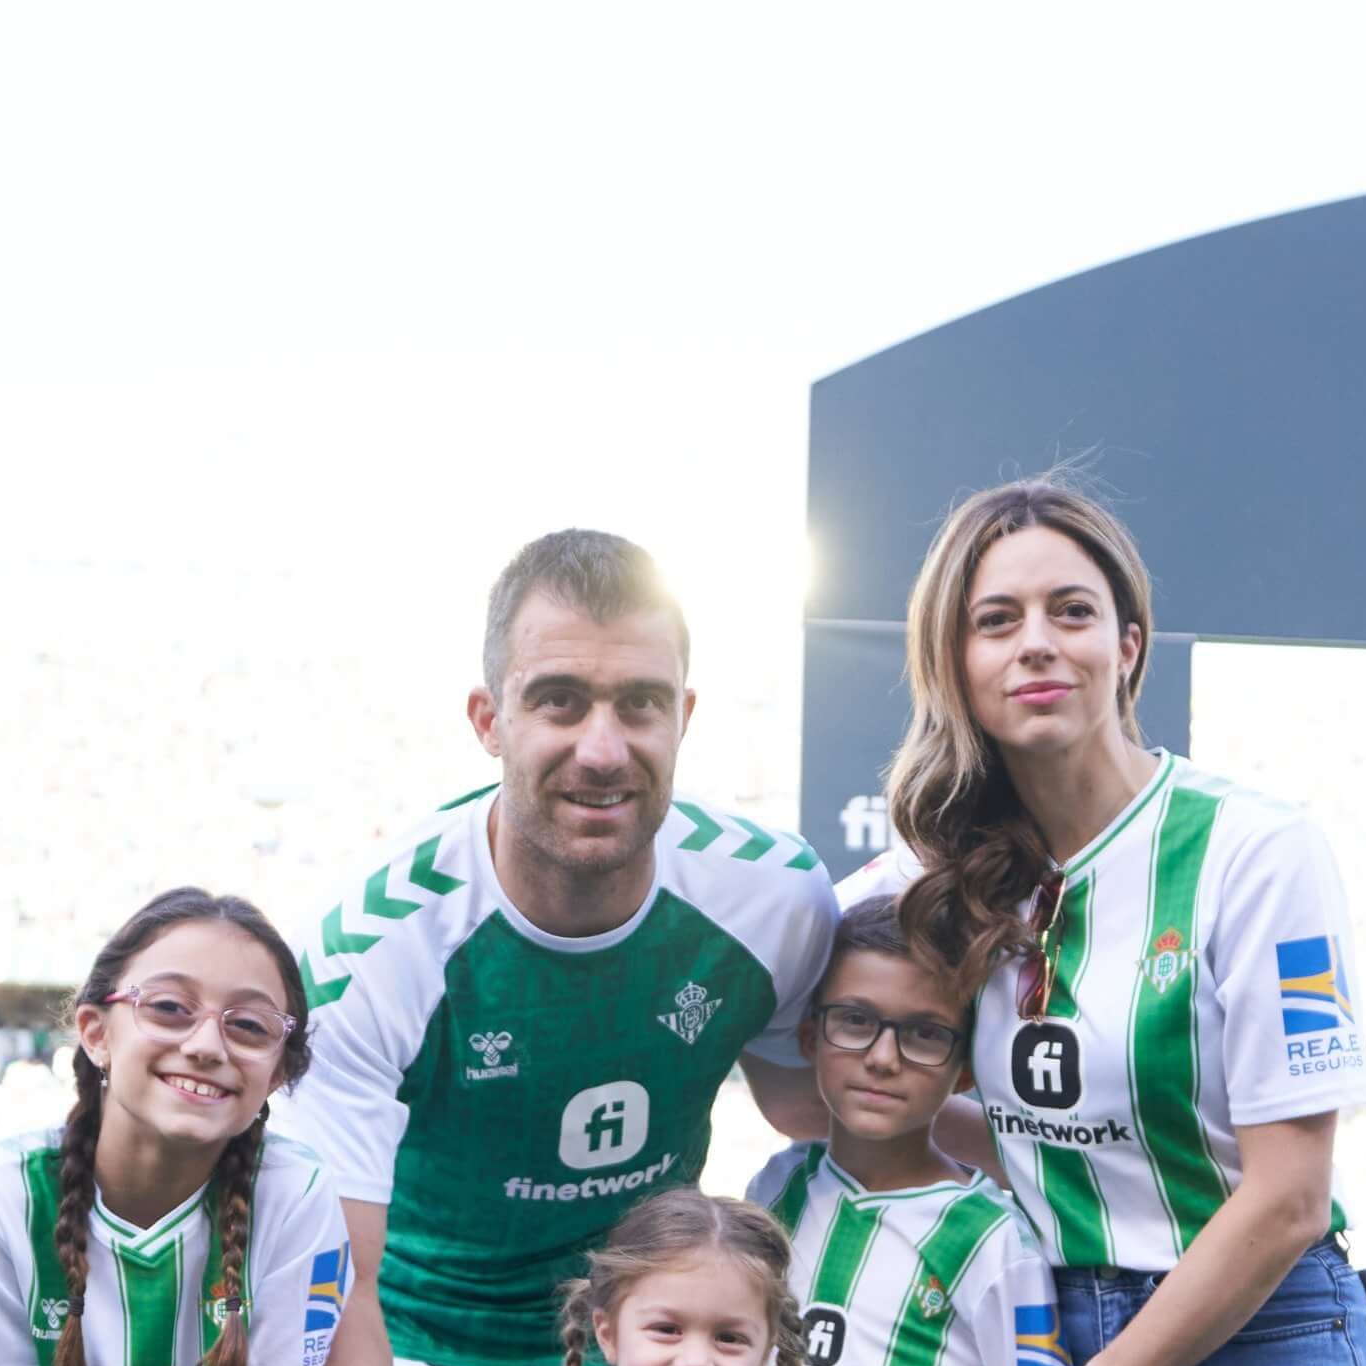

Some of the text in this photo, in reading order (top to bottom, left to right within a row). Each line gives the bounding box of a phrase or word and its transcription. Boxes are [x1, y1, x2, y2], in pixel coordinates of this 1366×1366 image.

[1027, 1040, 1063, 1093] fi
[584, 1100, 625, 1152] fi
[988, 1105, 1134, 1145] finetwork
[808, 1320, 835, 1358] fi
